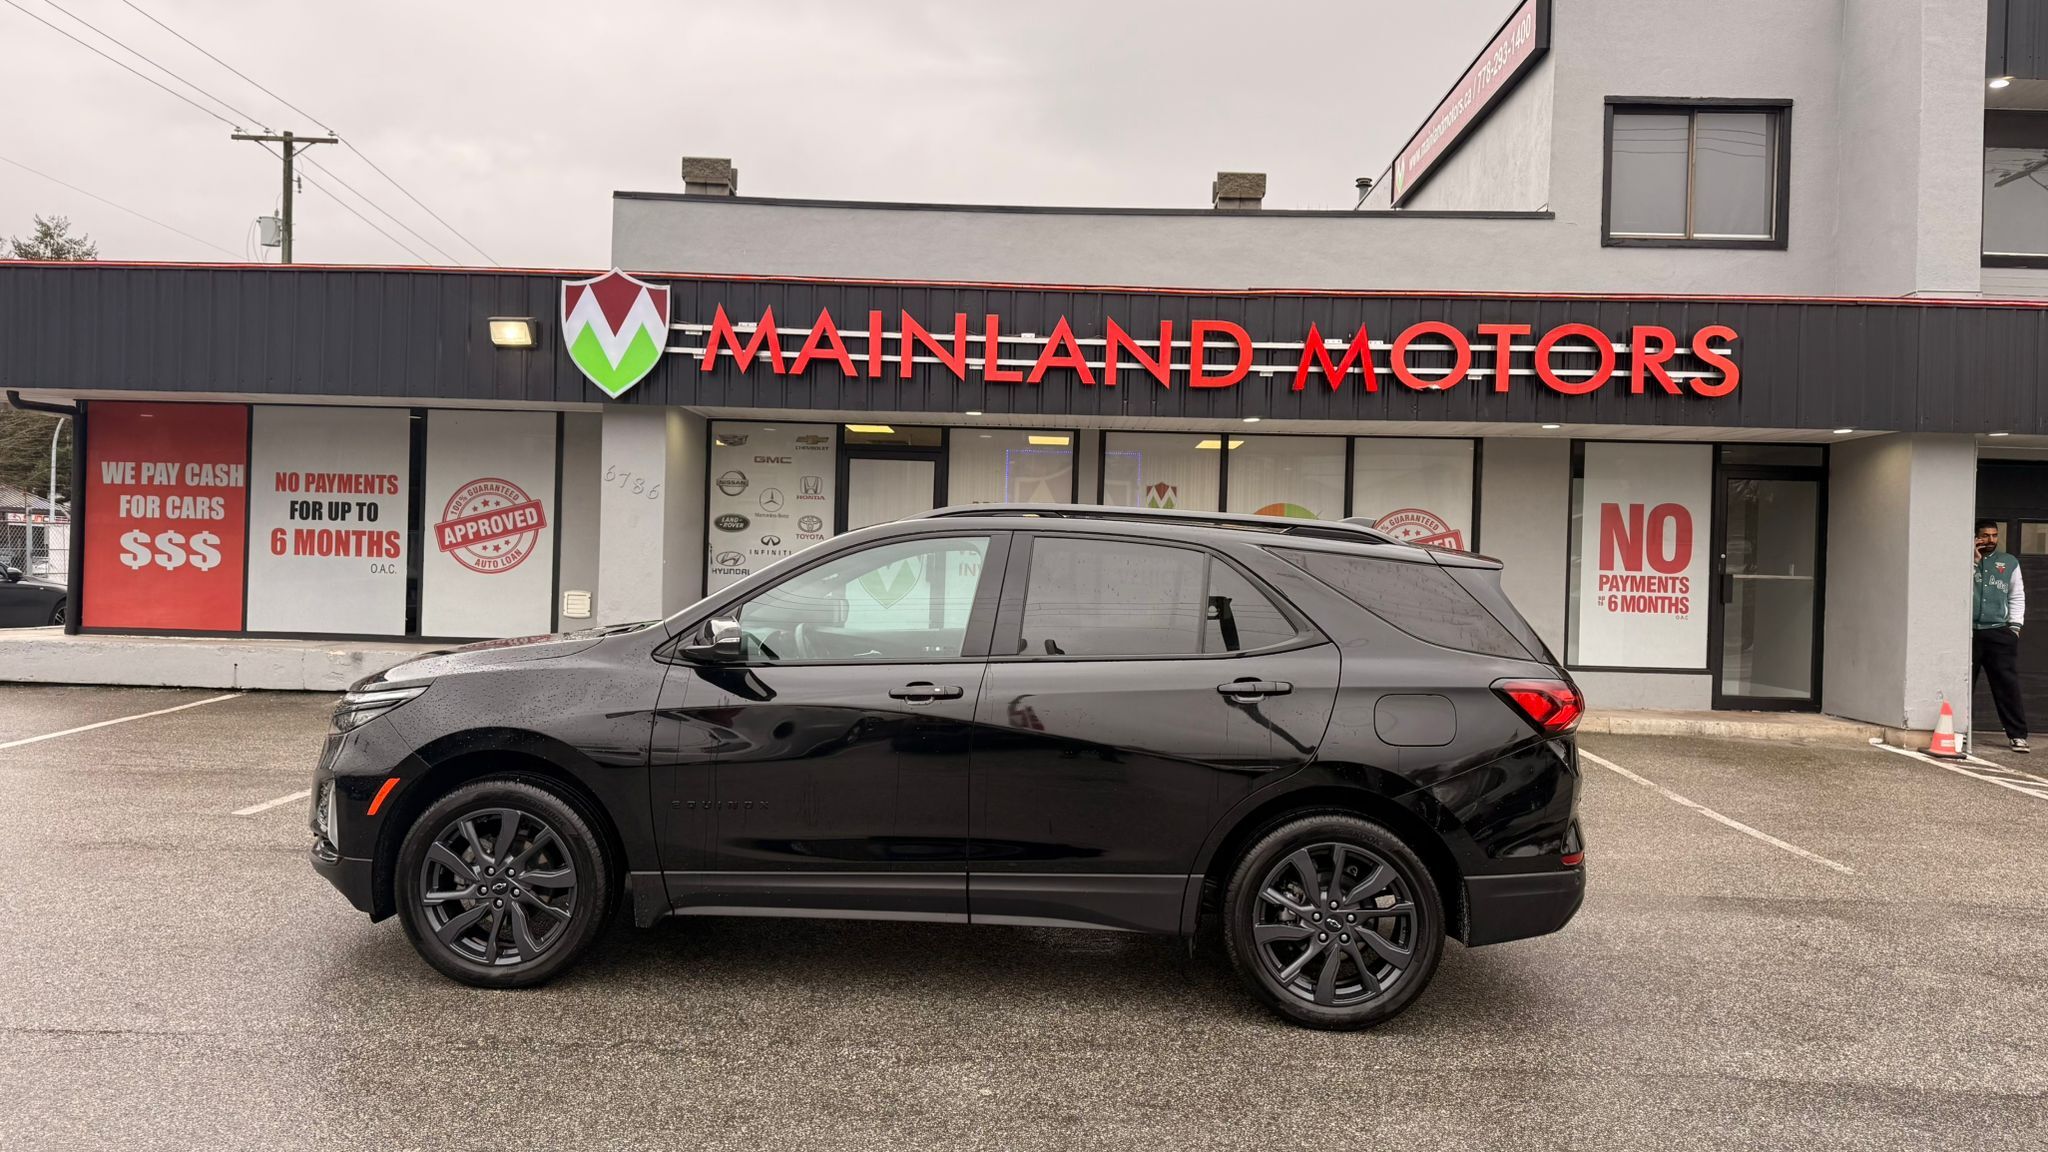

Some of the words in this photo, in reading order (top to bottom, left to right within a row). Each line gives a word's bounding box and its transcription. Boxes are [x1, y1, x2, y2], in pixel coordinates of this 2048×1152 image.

[1478, 13, 1532, 97] 778-293-1400
[701, 302, 1253, 389] MAINLAND
[1292, 320, 1740, 397] MOTORS
[754, 455, 793, 464] GMC
[101, 461, 136, 485] WE
[140, 462, 180, 485] PAY
[184, 463, 244, 487] CASH
[275, 471, 300, 492] NO
[304, 473, 399, 495] PAYMENTS
[604, 464, 661, 500] 6786
[119, 495, 160, 518] FOR
[166, 496, 225, 520] CARS
[289, 500, 323, 520] FOR
[327, 501, 352, 521] UP
[355, 502, 379, 522] TO
[450, 495, 468, 515] 100%
[467, 484, 520, 501] GUARANTEED
[444, 507, 539, 545] APPROVED
[1388, 514, 1439, 531] GUARANTEED
[270, 527, 287, 555] 6
[294, 528, 401, 558] MONTHS
[1599, 502, 1693, 574] NO
[119, 529, 222, 572] $$$
[474, 558, 499, 568] AUTO
[500, 549, 523, 567] LOAN
[370, 563, 397, 574] O.A.C.
[712, 567, 751, 576] HYUNDAI
[1599, 574, 1690, 594] PAYMENTS
[1607, 594, 1619, 612] 6
[1620, 595, 1690, 614] MONTHS
[671, 800, 769, 810] EQUINOX
